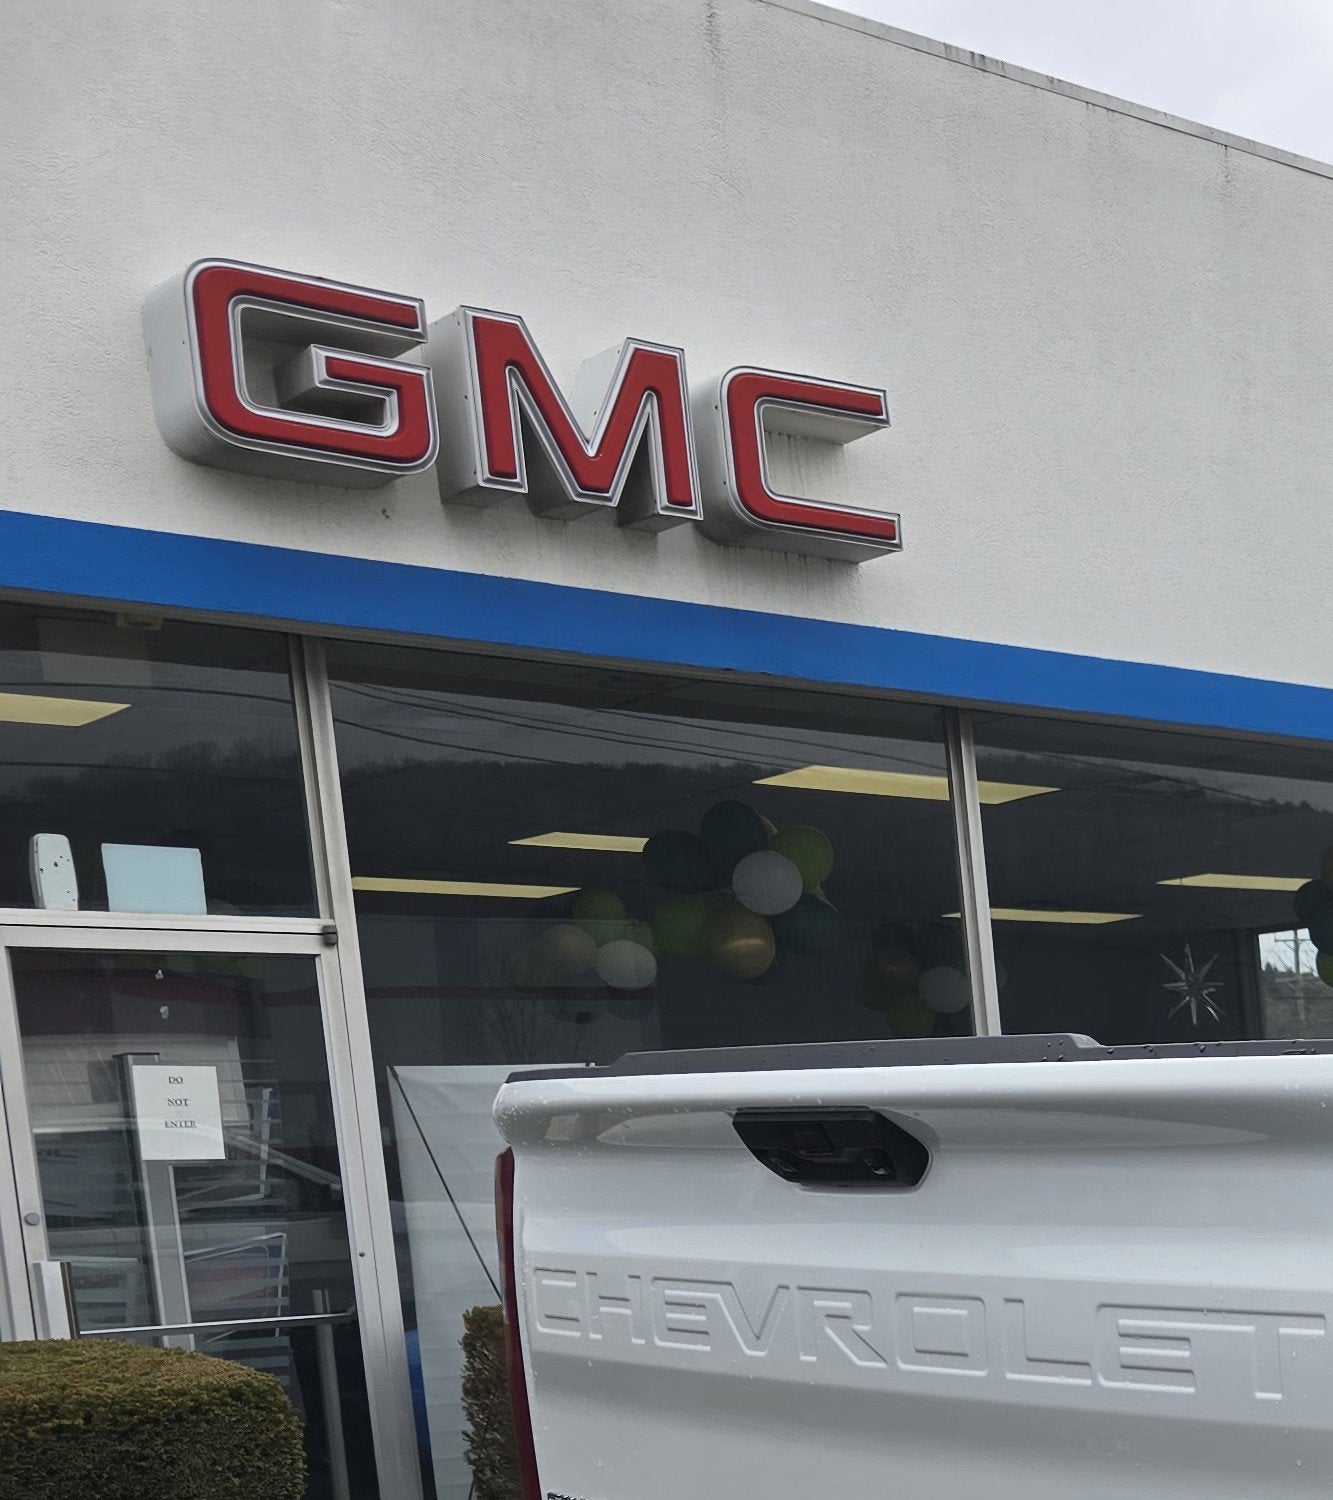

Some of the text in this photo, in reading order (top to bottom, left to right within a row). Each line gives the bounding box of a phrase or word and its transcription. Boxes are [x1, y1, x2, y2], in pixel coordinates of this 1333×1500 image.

[178, 256, 903, 556] GMC
[167, 1098, 190, 1107] NOT
[168, 1076, 184, 1085] DO
[532, 1266, 1327, 1401] CHEVROLET
